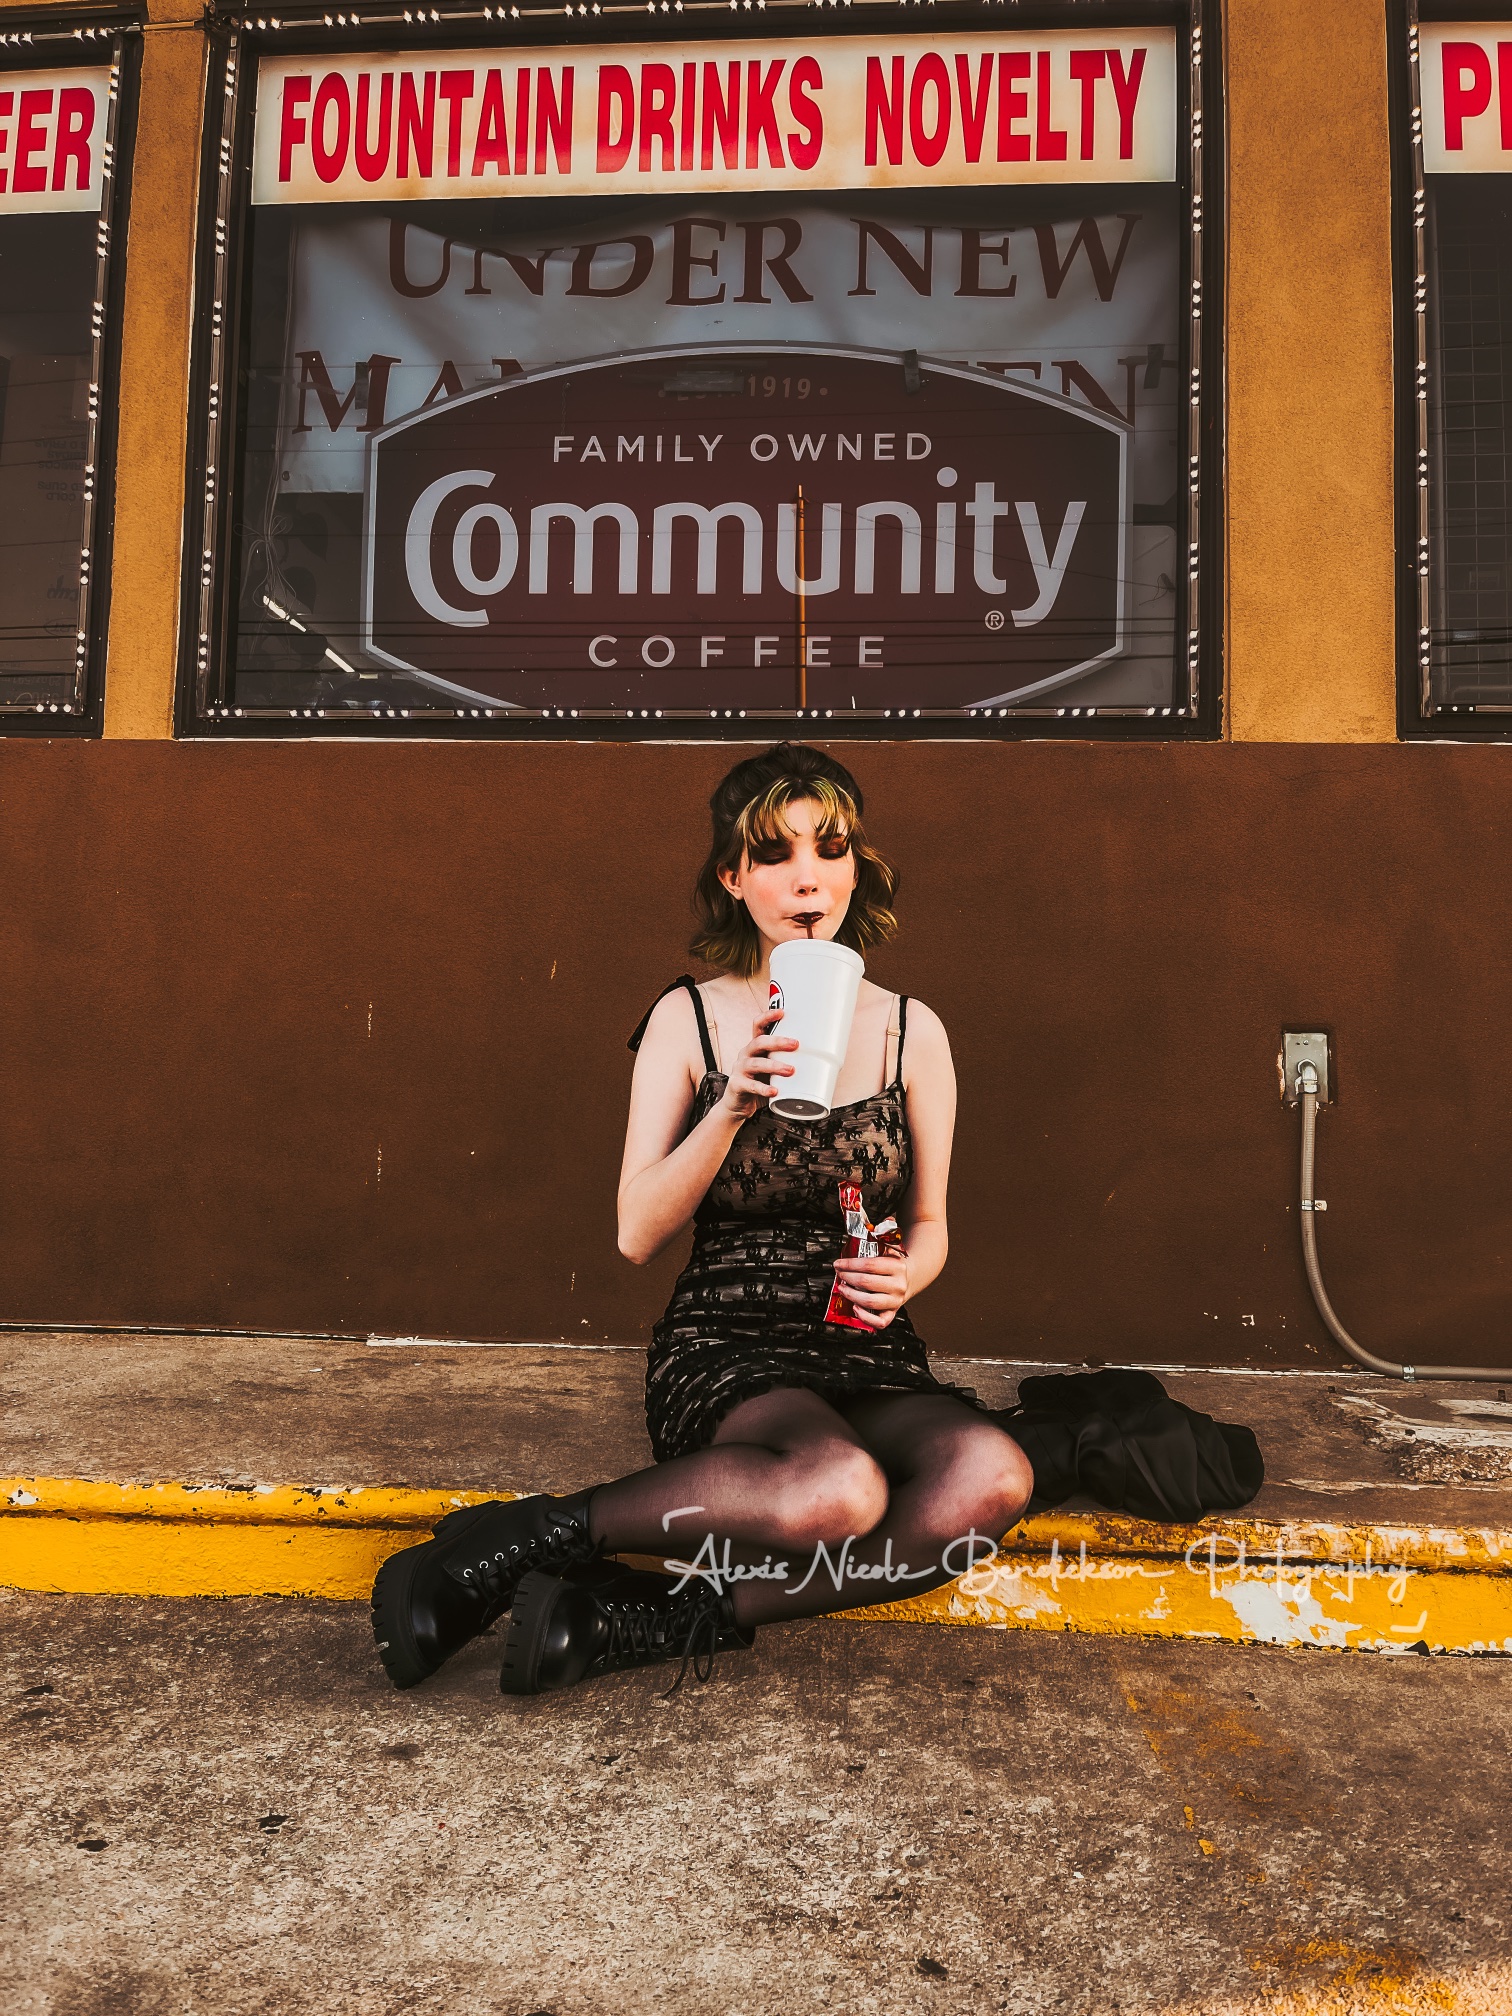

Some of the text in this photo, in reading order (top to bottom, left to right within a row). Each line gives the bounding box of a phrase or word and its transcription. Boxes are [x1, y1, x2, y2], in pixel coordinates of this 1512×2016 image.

[279, 48, 1147, 183] FOUNTAIN DRINKS NOVELTY
[388, 213, 1143, 307] UNDER NEW
[747, 376, 811, 400] 1919
[554, 432, 932, 463] FAMILY OWNED
[405, 467, 1087, 628] Community
[588, 635, 884, 668] COFFEE
